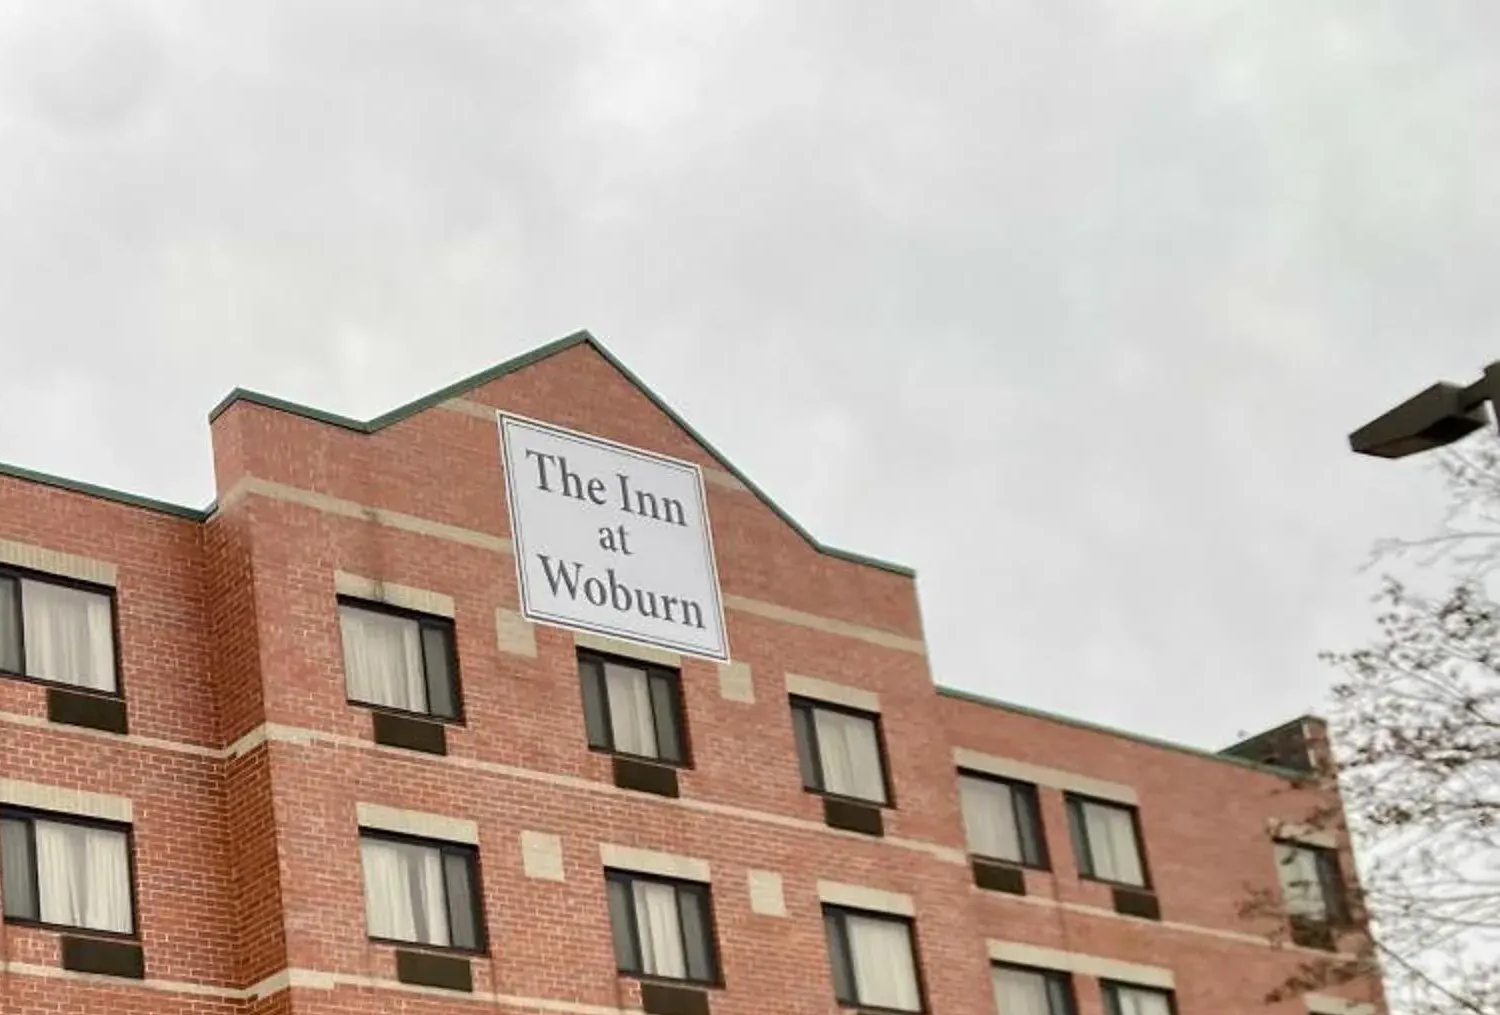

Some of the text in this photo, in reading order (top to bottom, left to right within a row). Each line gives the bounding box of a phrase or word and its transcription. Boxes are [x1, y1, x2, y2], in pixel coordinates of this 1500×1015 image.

[525, 449, 687, 527] The Inn
[598, 524, 634, 555] at
[537, 553, 706, 629] Woburn
